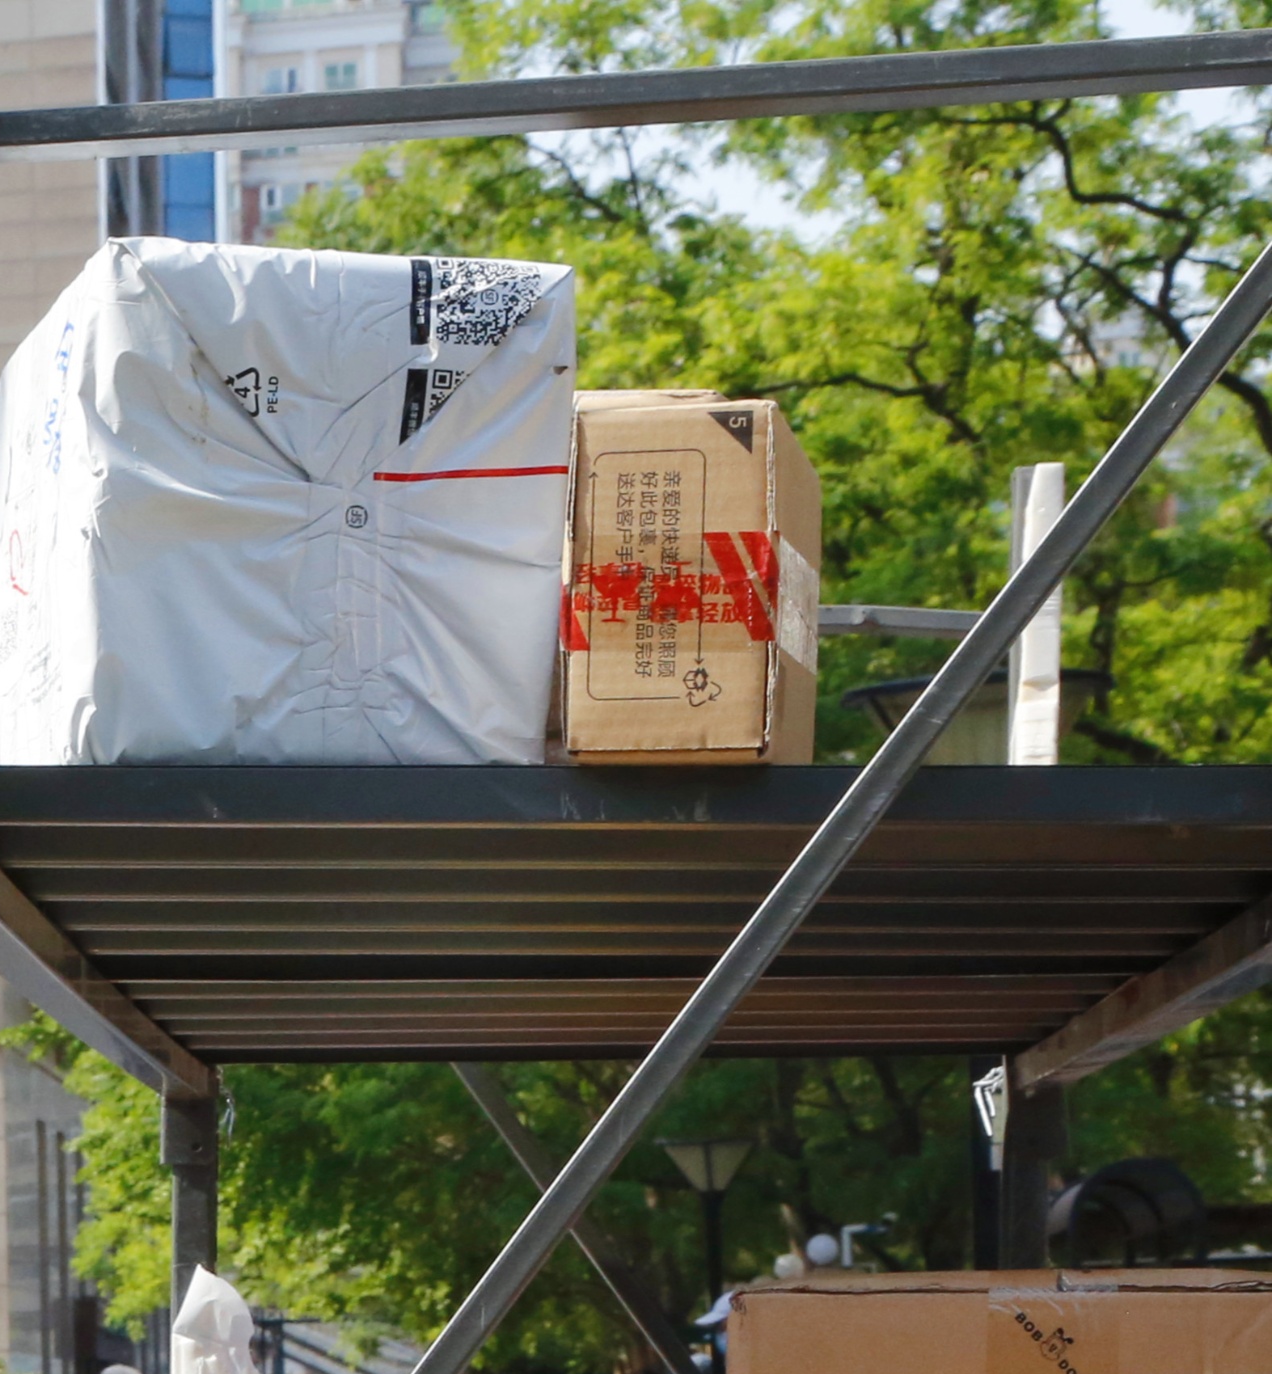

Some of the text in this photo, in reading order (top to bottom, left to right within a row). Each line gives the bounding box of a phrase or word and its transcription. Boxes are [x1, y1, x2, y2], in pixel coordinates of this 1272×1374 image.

[267, 376, 280, 414] PE-LD
[729, 415, 747, 429] 5
[1015, 1312, 1043, 1341] BOB
